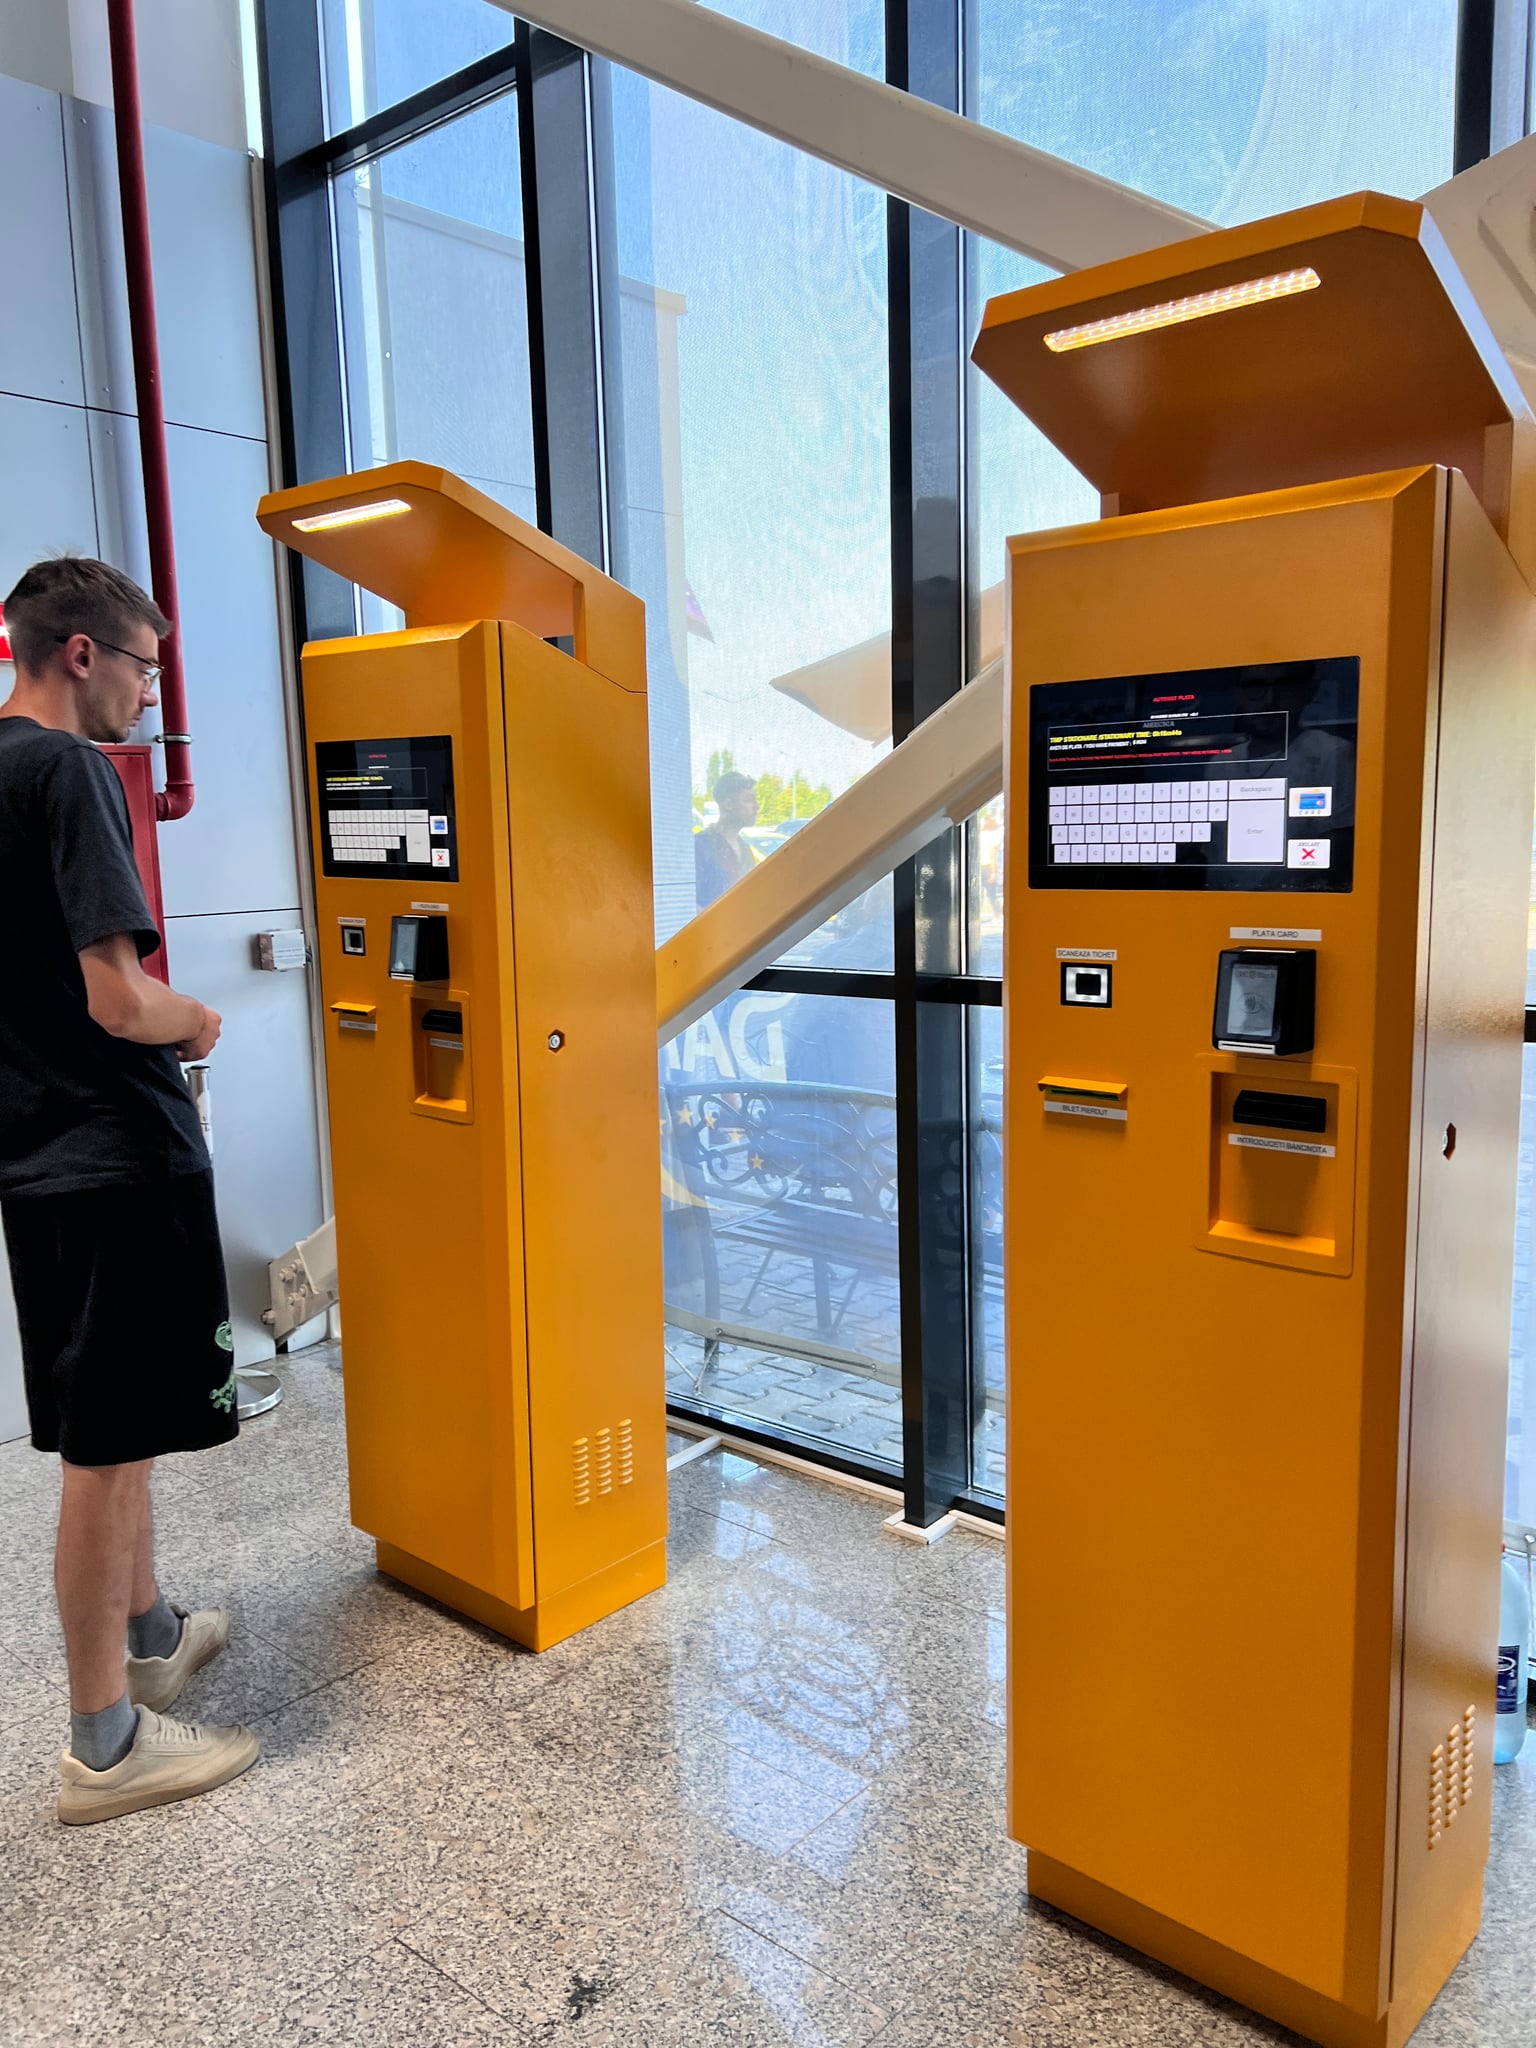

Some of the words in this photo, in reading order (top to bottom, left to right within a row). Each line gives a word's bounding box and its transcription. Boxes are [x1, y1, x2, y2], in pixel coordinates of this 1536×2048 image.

[1251, 929, 1275, 937] PLATA
[1057, 949, 1090, 958] SCANEAZA
[1092, 950, 1115, 959] TICHET
[1062, 1104, 1080, 1113] BILET
[1080, 1106, 1108, 1116] PIERDUT
[1237, 1136, 1285, 1148] INTRODUCETI
